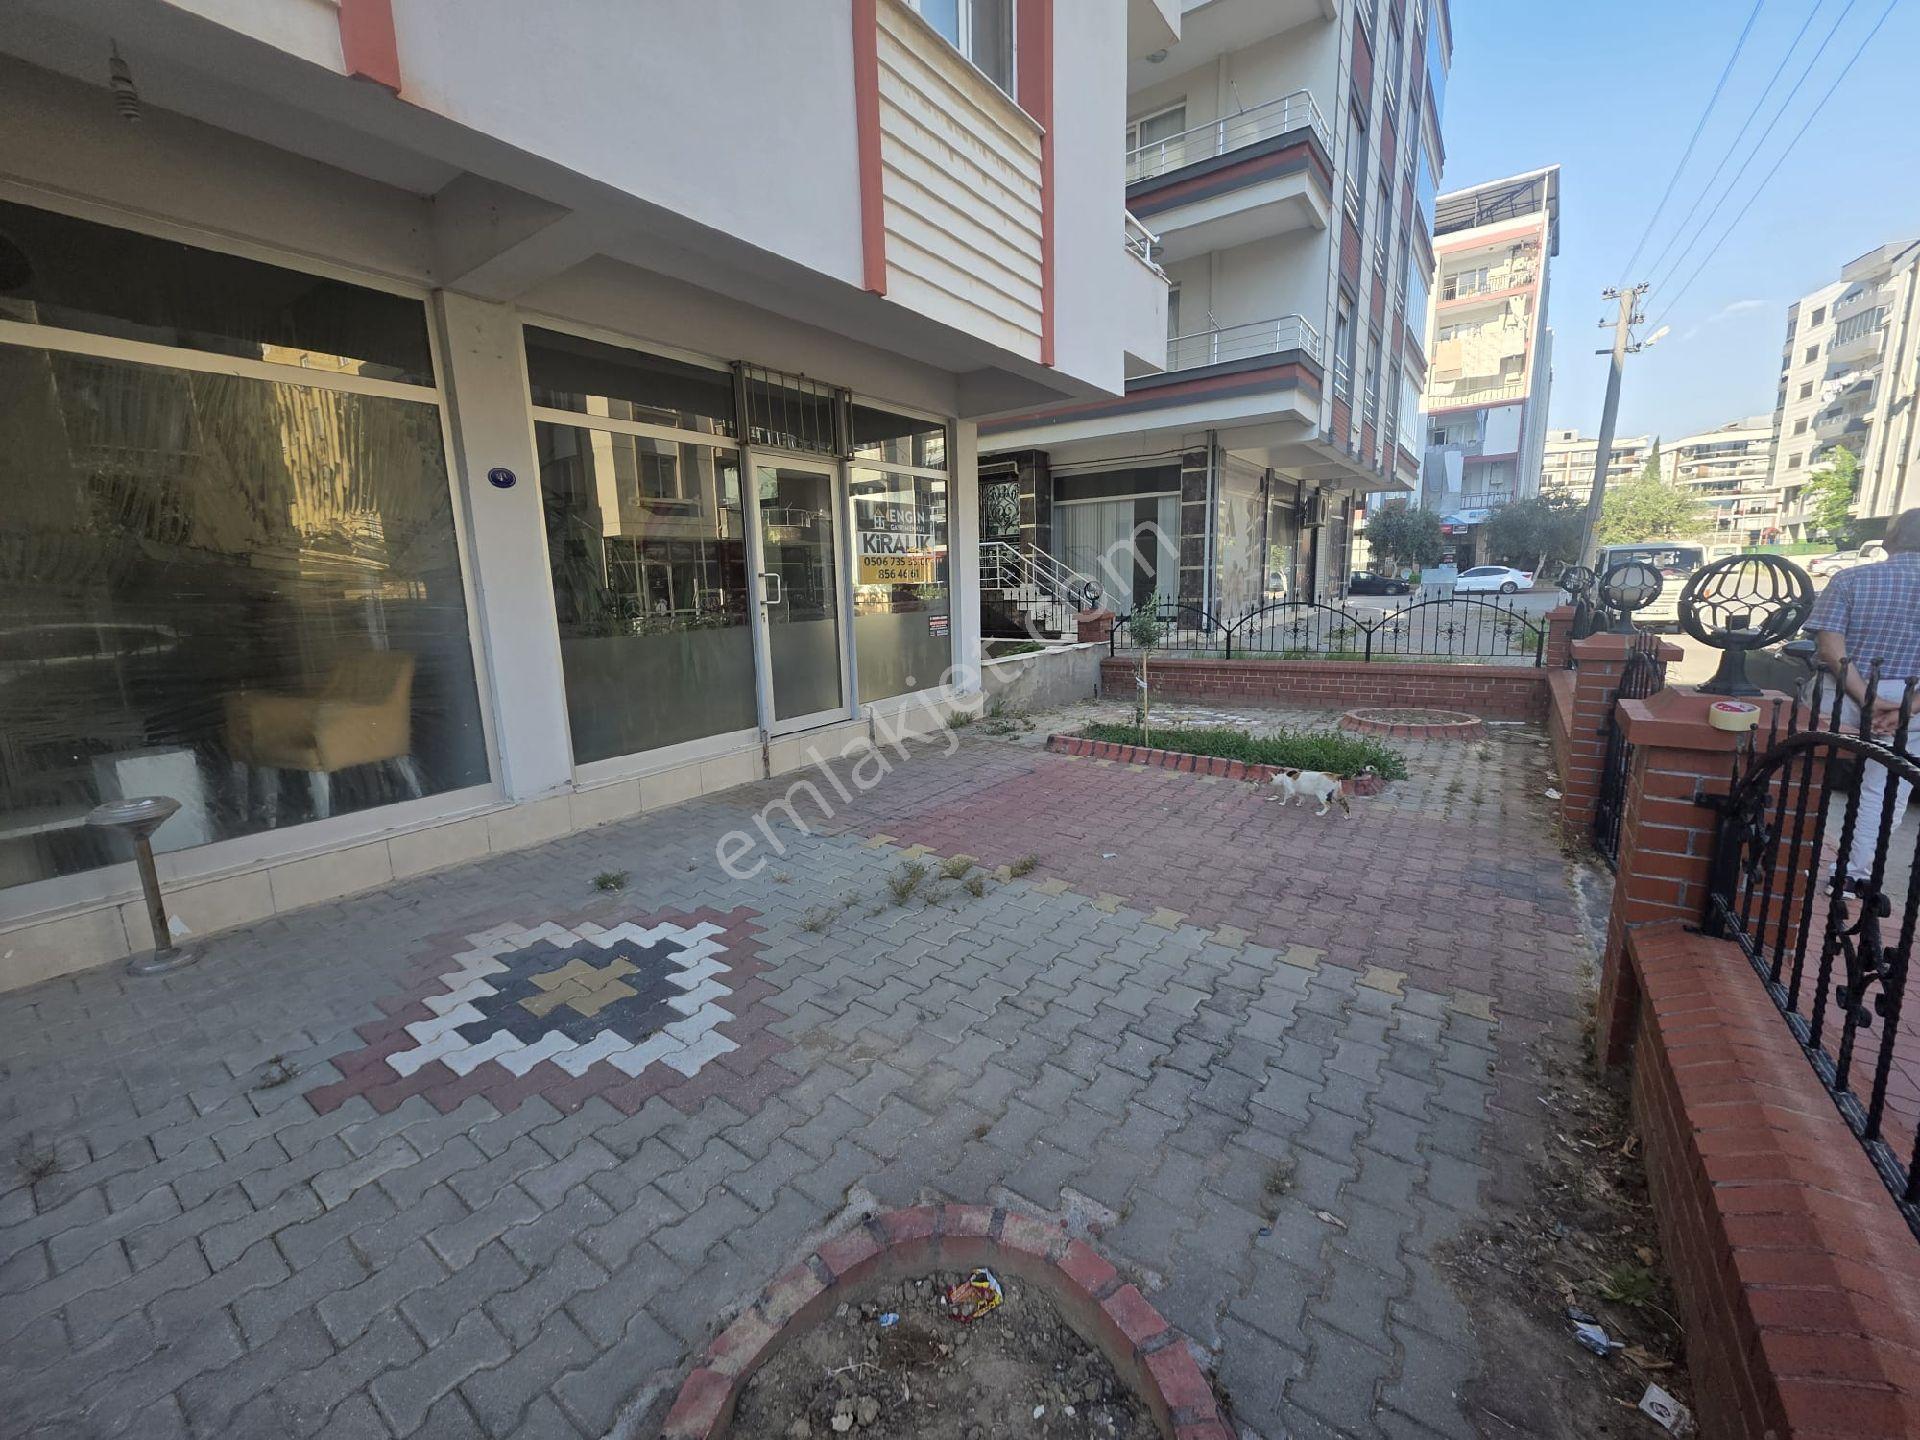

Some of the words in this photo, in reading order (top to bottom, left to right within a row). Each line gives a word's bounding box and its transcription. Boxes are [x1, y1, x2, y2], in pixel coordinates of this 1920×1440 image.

[890, 509, 925, 525] ENGN
[864, 556, 888, 566] 0506
[890, 556, 906, 566] 735
[878, 569, 896, 579] 856
